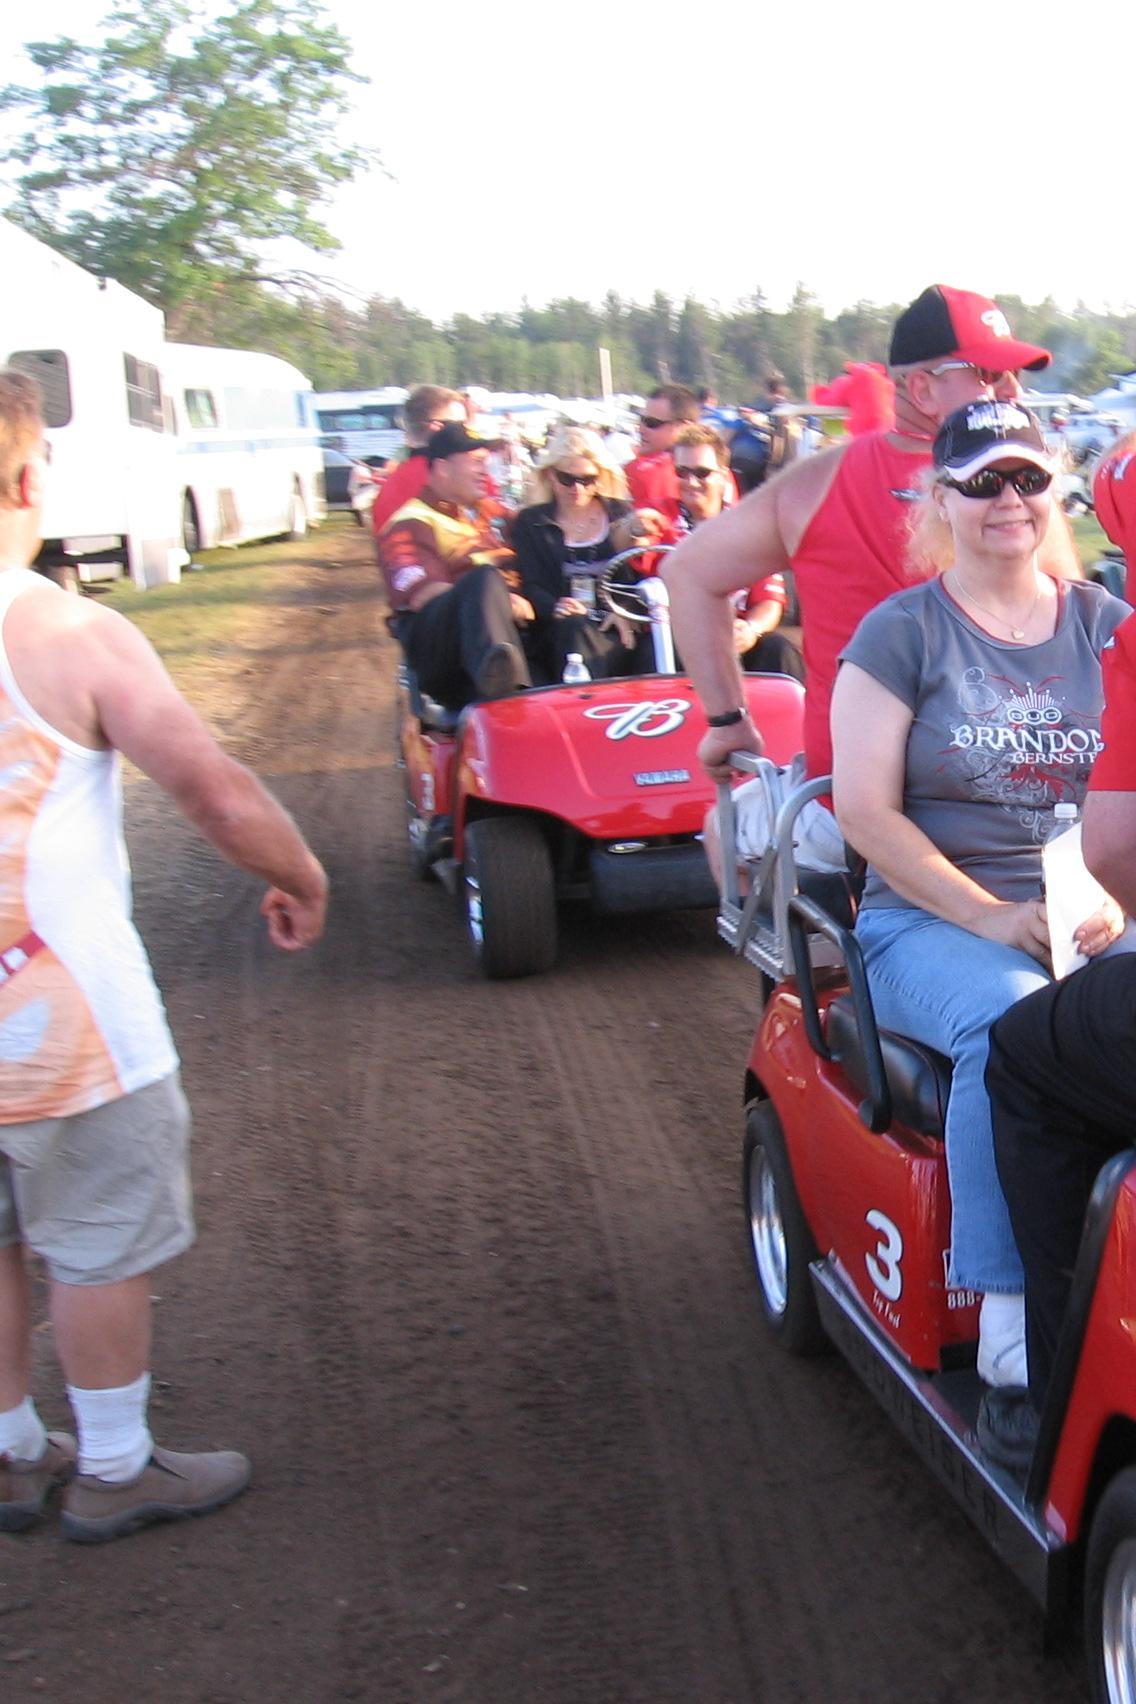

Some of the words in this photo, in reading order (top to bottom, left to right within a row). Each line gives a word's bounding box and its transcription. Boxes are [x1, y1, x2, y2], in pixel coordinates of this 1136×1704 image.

[582, 698, 692, 741] B
[1008, 751, 1098, 766] BERNSTE
[864, 1207, 904, 1302] 3
